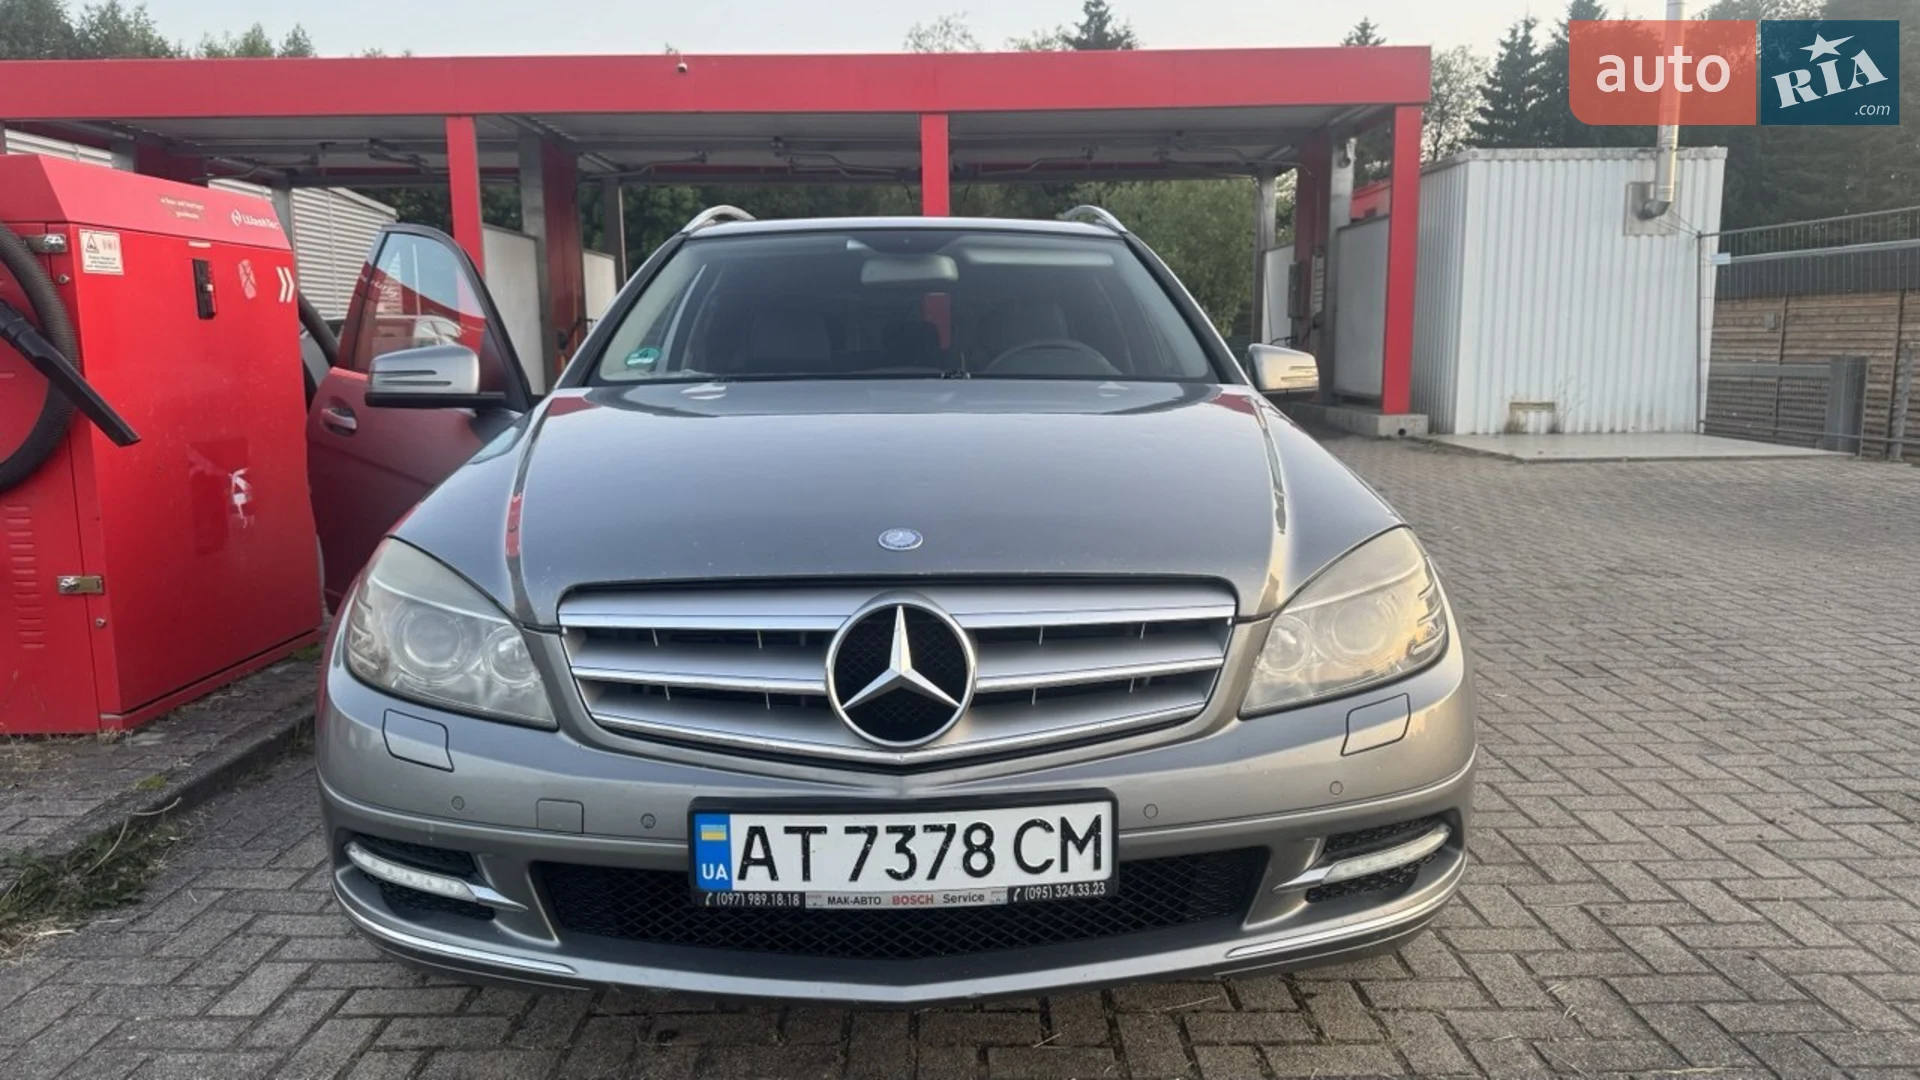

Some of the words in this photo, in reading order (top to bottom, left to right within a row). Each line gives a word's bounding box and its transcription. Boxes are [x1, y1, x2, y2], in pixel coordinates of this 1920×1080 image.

[737, 825, 828, 881] AT
[844, 821, 996, 882] 7378
[1013, 814, 1102, 876] CM
[702, 863, 729, 881] UA
[716, 893, 745, 907] (097)
[892, 894, 934, 906] BOSCH
[943, 893, 985, 904] Service
[1024, 885, 1053, 901] (095)
[1055, 882, 1106, 898] 324.33.23
